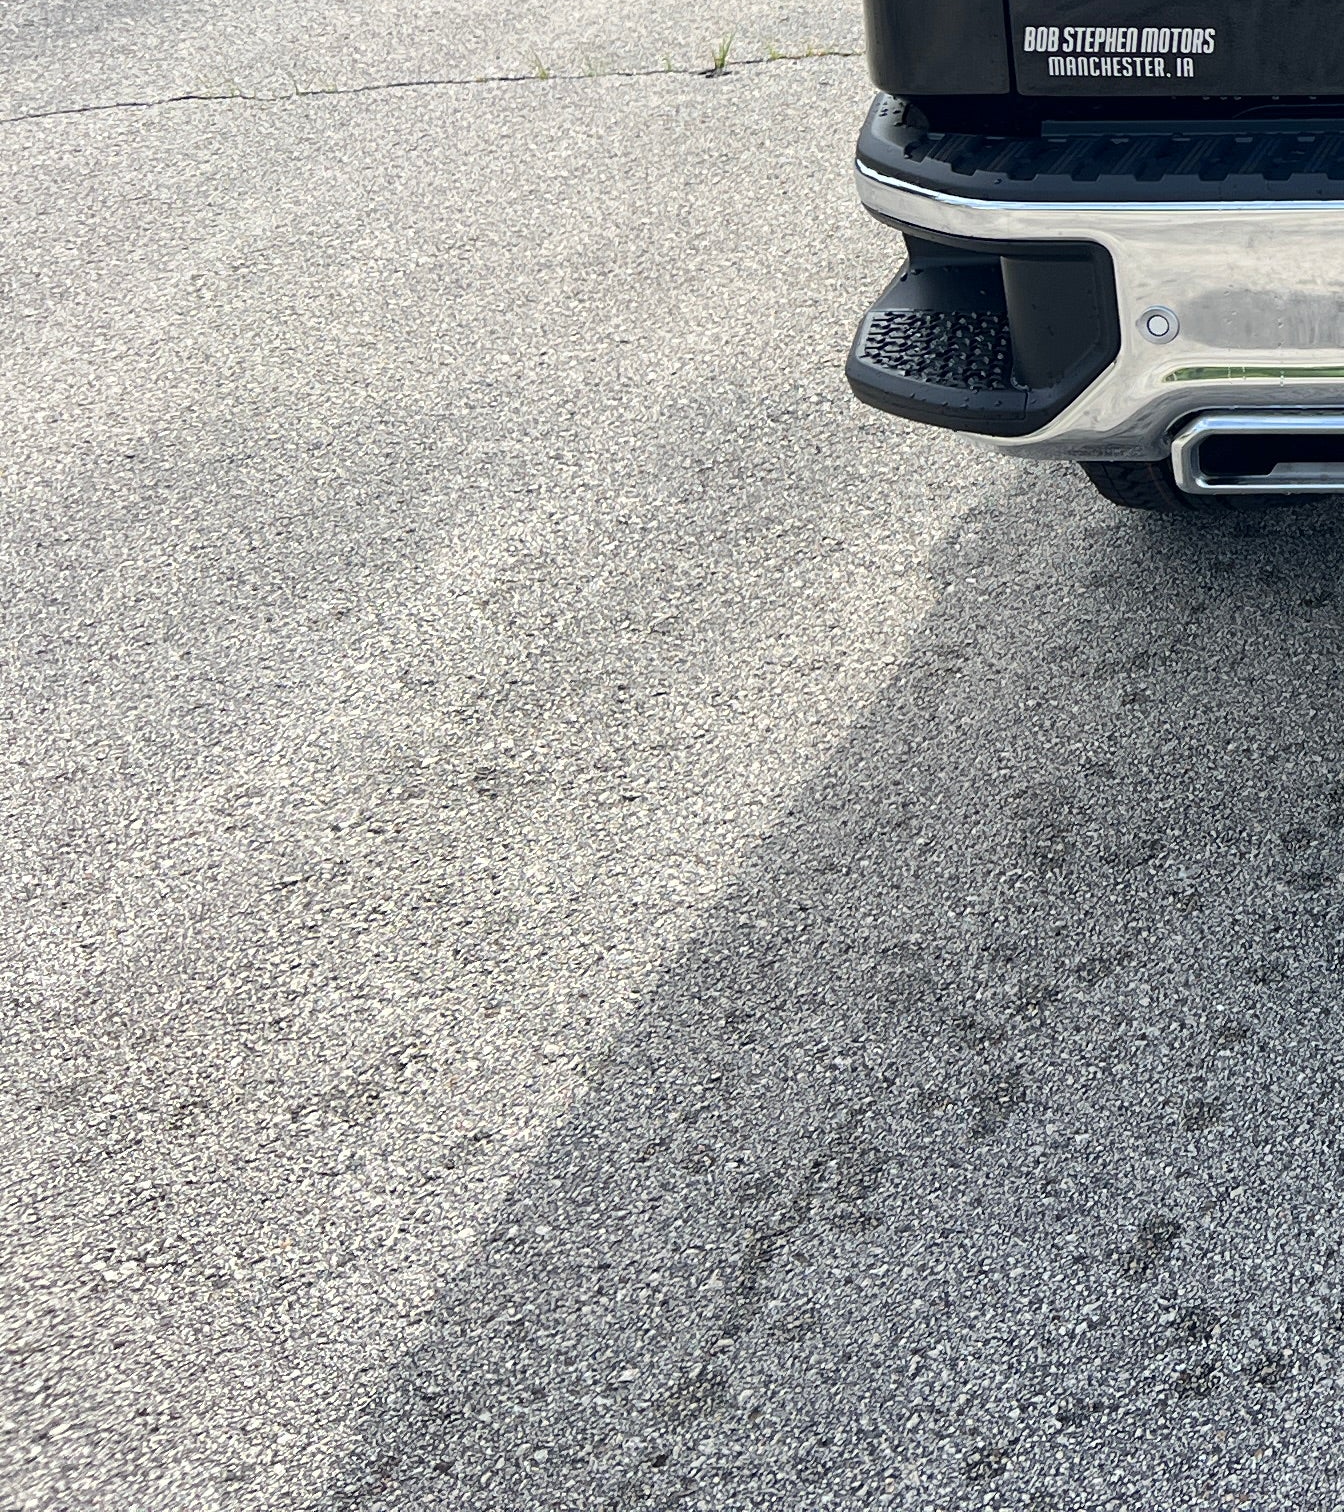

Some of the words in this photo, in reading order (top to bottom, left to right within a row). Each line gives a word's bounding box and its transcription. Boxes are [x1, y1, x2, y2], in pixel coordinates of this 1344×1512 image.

[1023, 26, 1059, 52] BOB
[1062, 27, 1137, 53] STEPHEN
[1141, 27, 1216, 54] MOTORS
[1176, 57, 1194, 78] IA
